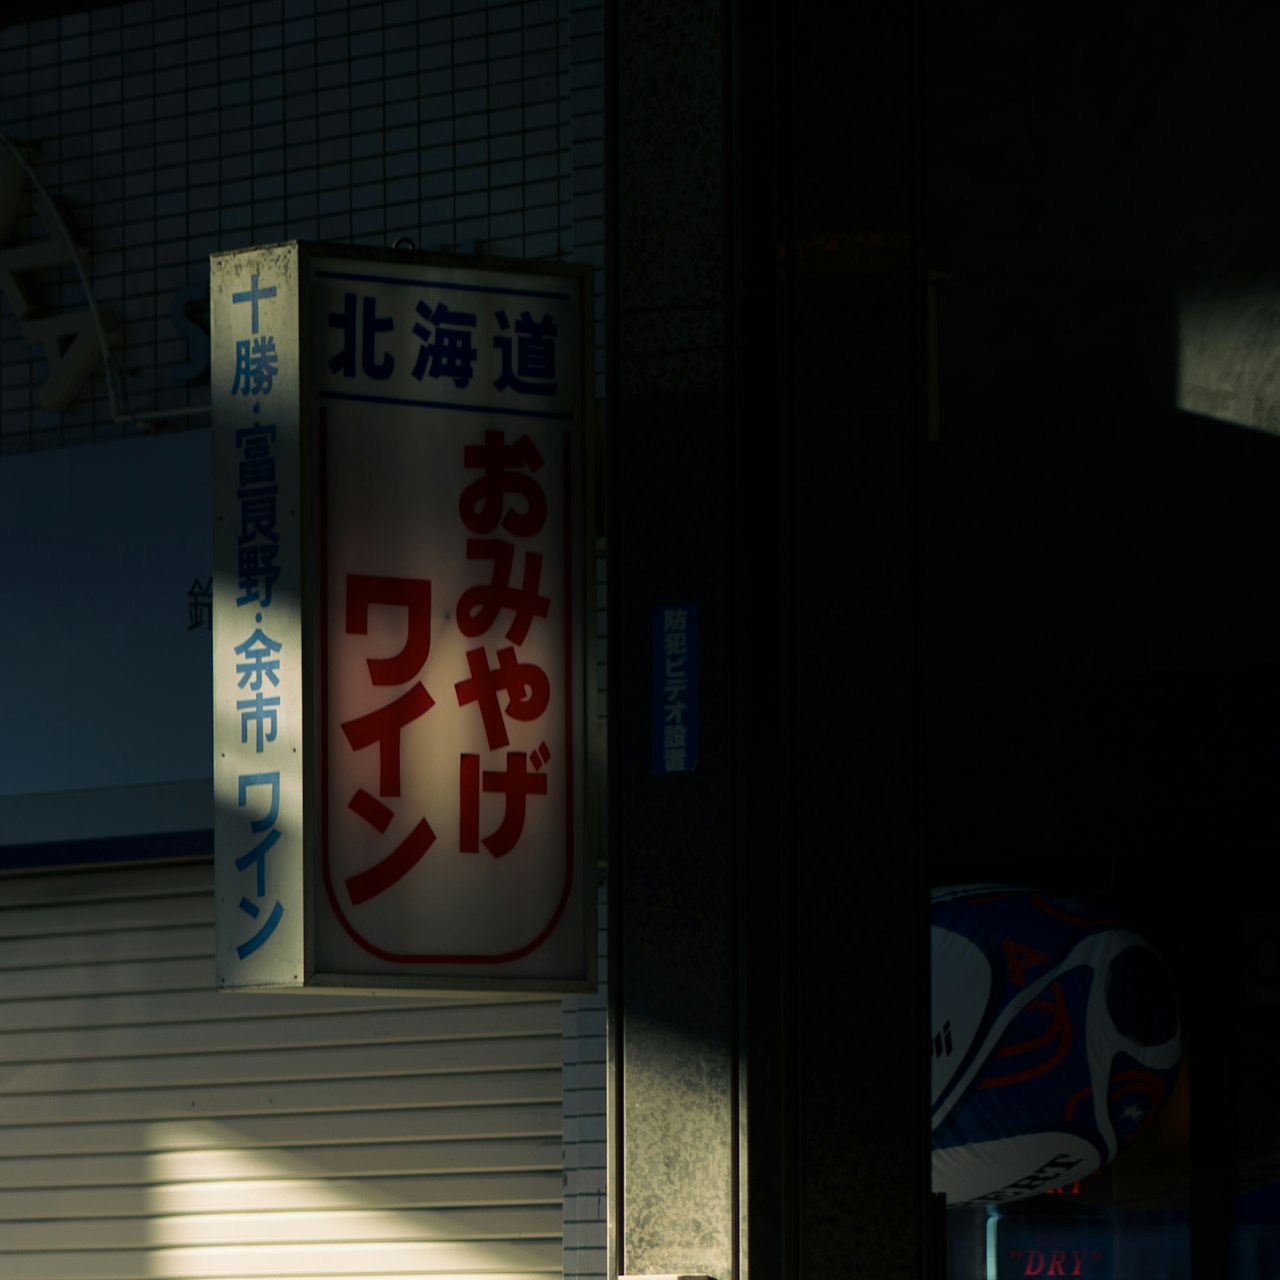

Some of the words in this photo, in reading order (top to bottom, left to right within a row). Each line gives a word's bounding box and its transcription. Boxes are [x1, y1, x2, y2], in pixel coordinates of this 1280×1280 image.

[327, 293, 558, 397] 北海道
[341, 575, 436, 905] ワイン
[454, 429, 552, 859] おみやげ
[663, 607, 688, 773] 防犯ビデオ設置
[234, 769, 284, 961] ワイン
